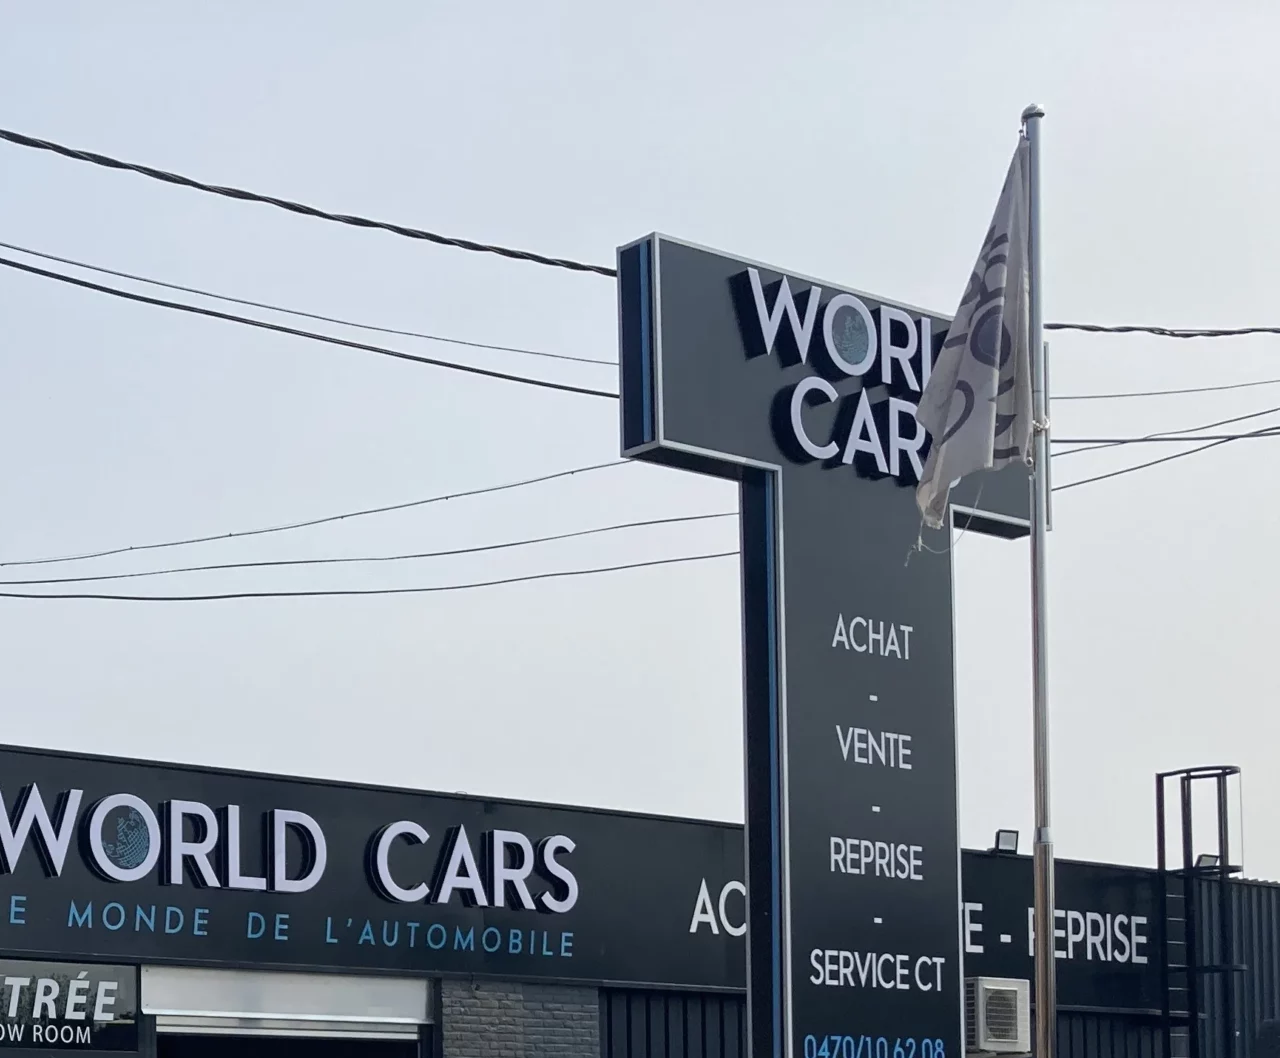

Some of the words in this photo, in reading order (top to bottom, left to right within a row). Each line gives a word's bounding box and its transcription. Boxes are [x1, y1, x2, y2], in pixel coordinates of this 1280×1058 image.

[746, 266, 933, 392] WORL
[790, 376, 927, 479] CAR
[832, 613, 913, 660] ACHAT
[835, 725, 912, 770] VENTE
[375, 820, 579, 914] CARS
[830, 836, 923, 881] REPRISE
[68, 902, 209, 938] MONDE
[248, 912, 289, 942] DE
[326, 917, 575, 958] L'AUTOMOBILE
[809, 948, 910, 990] SERVICE
[914, 955, 946, 992] CT
[32, 1025, 92, 1044] ROOM
